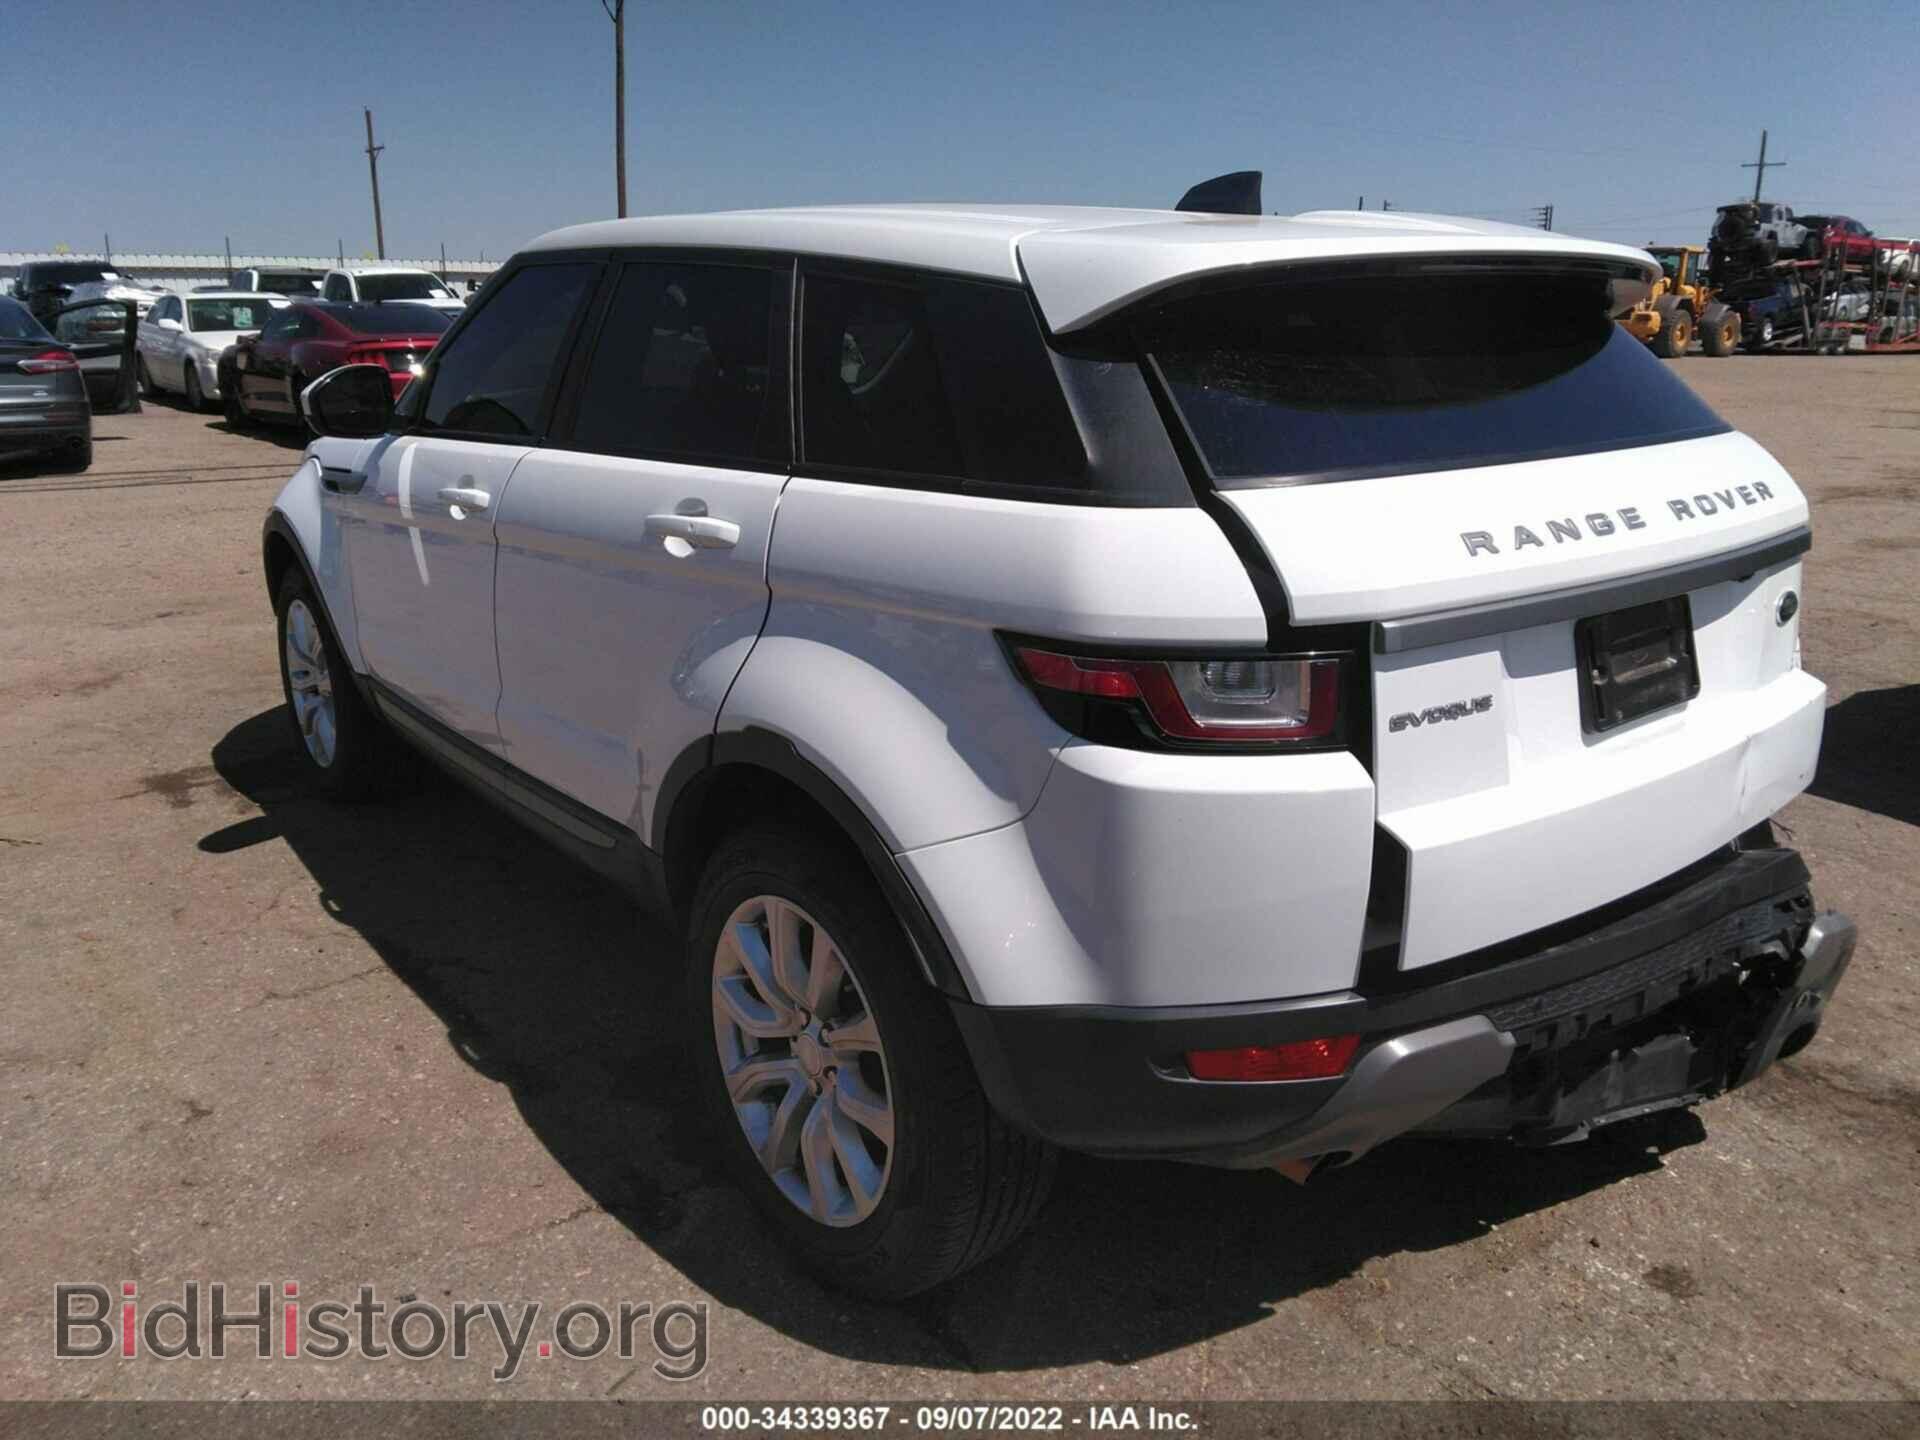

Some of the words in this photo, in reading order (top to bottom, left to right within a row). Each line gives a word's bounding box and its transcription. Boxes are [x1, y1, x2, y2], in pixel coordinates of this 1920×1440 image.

[1460, 506, 1647, 557] RANGE
[1666, 481, 1775, 521] ROVER
[1388, 694, 1494, 733] EVOQUE
